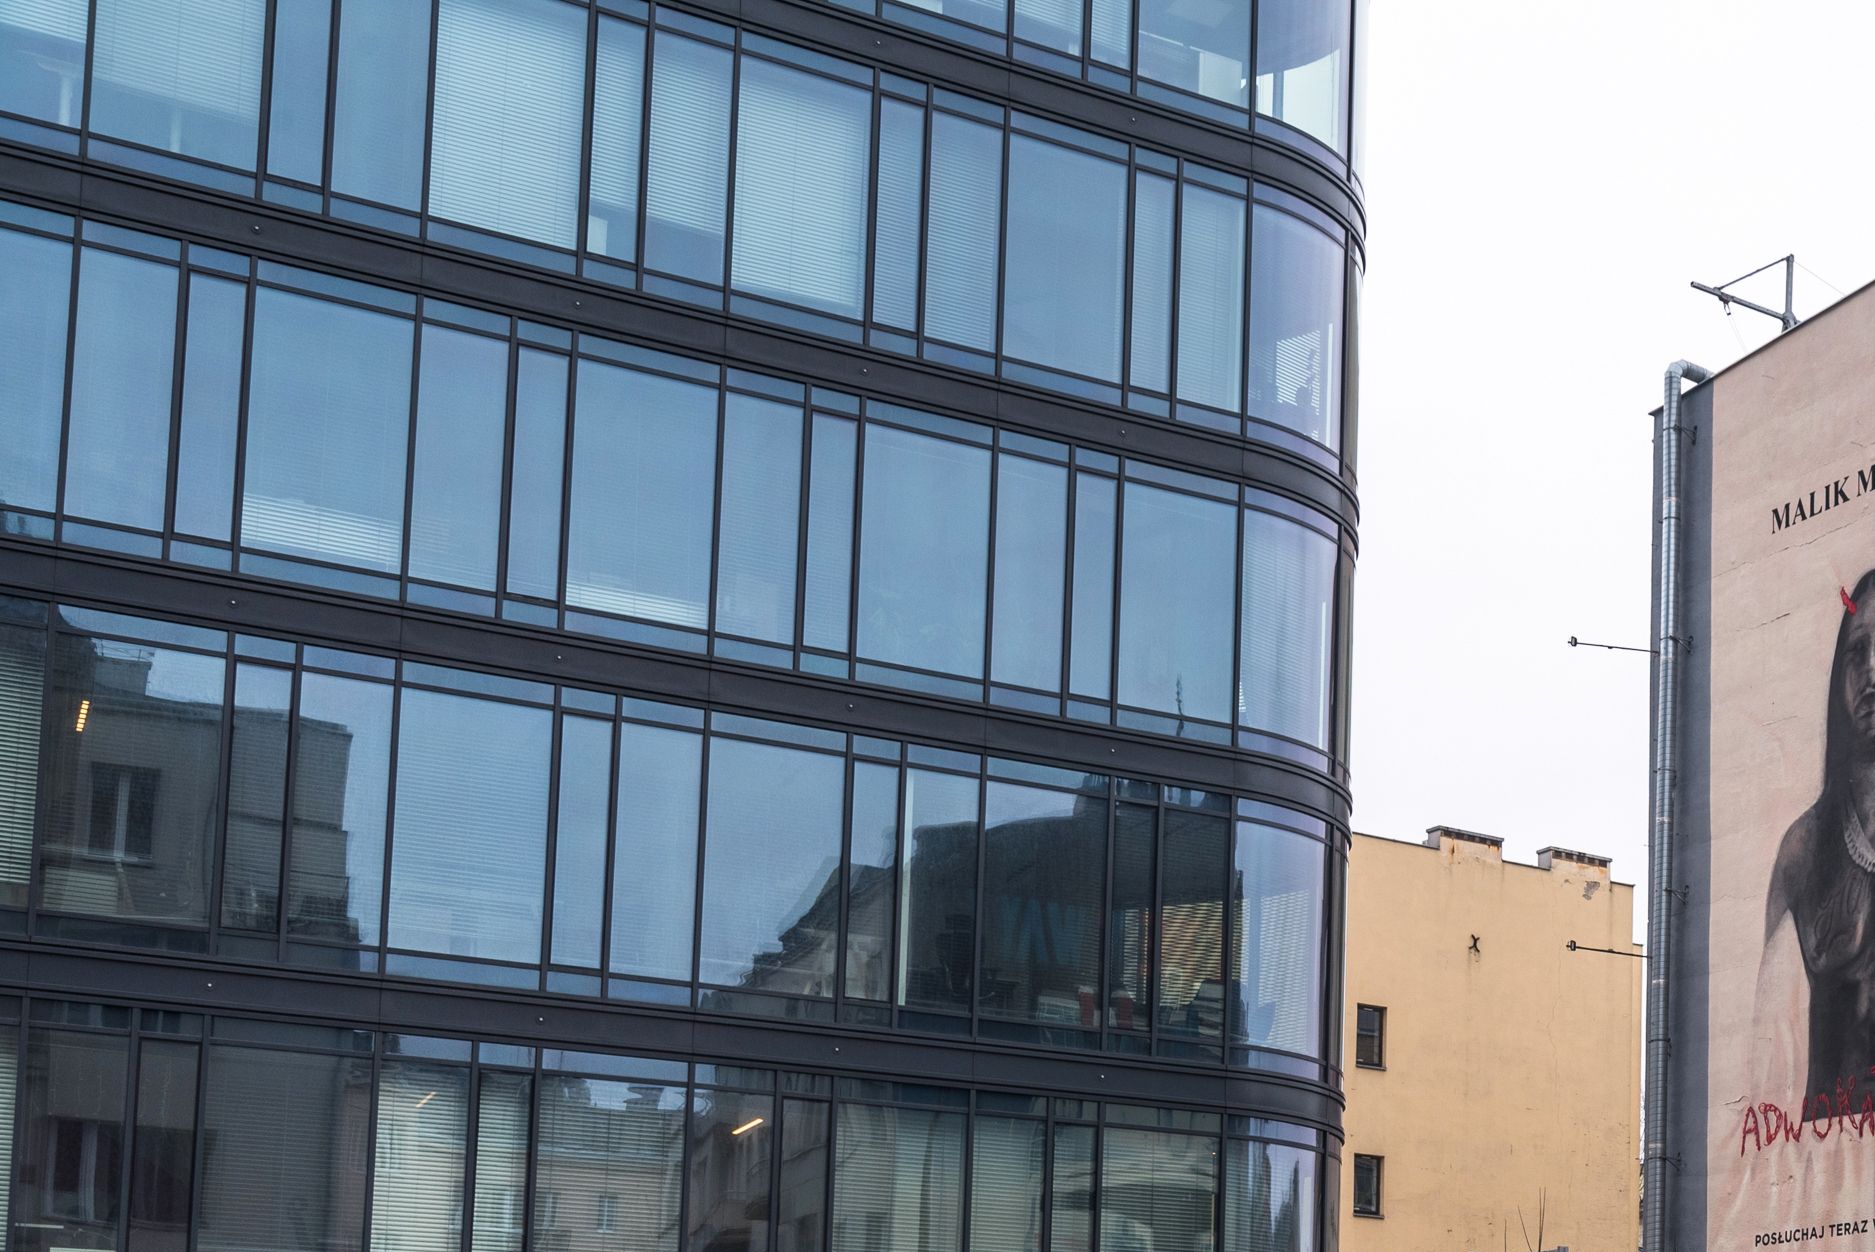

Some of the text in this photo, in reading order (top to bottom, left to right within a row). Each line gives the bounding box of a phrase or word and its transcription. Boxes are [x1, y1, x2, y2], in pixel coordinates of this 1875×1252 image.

[1771, 475, 1851, 535] MALIK
[1755, 1225, 1825, 1248] POSŁUCHAJ
[1828, 1219, 1868, 1237] TERAZ
